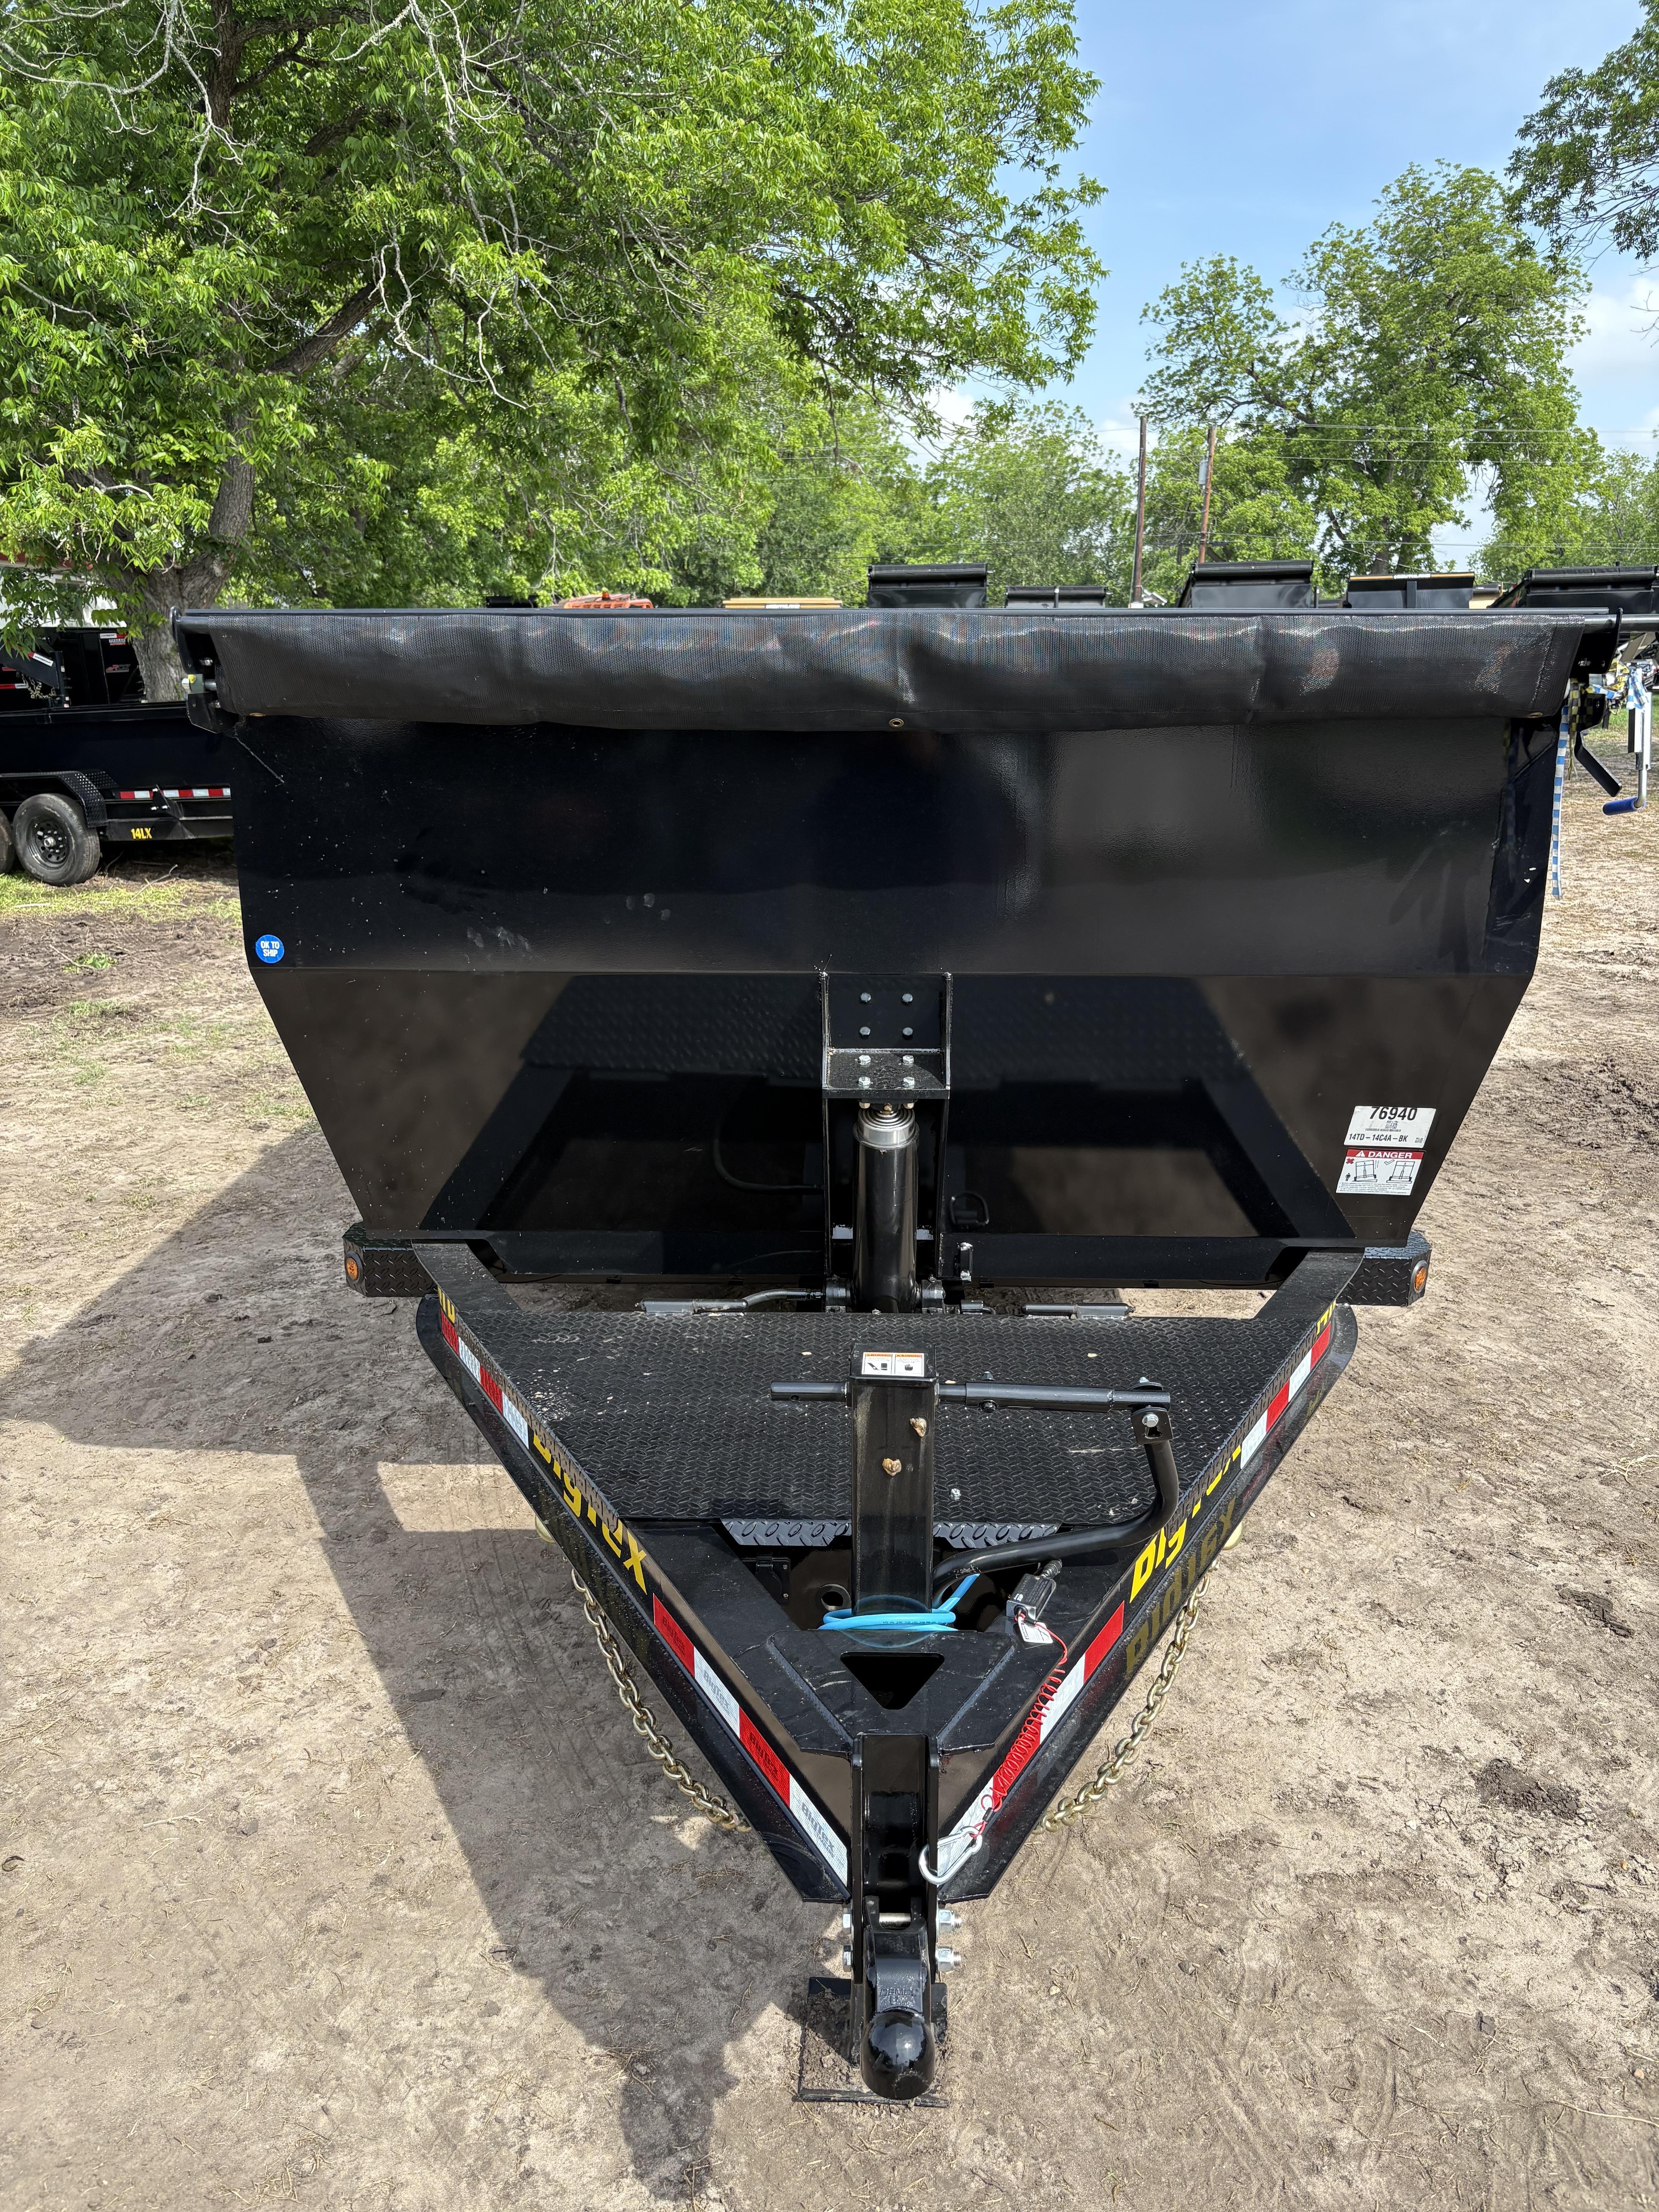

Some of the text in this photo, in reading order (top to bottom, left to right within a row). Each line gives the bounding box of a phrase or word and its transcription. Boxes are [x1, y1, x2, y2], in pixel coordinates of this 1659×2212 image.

[131, 828, 153, 839] 14LX
[261, 941, 280, 949] OK TO
[263, 949, 278, 957] SHIP
[1369, 1106, 1417, 1121] 76940
[1368, 1151, 1413, 1159] DANGER
[703, 1669, 729, 1708] BigTex
[750, 1731, 778, 1774] BigTex
[802, 1802, 834, 1850] BigTex
